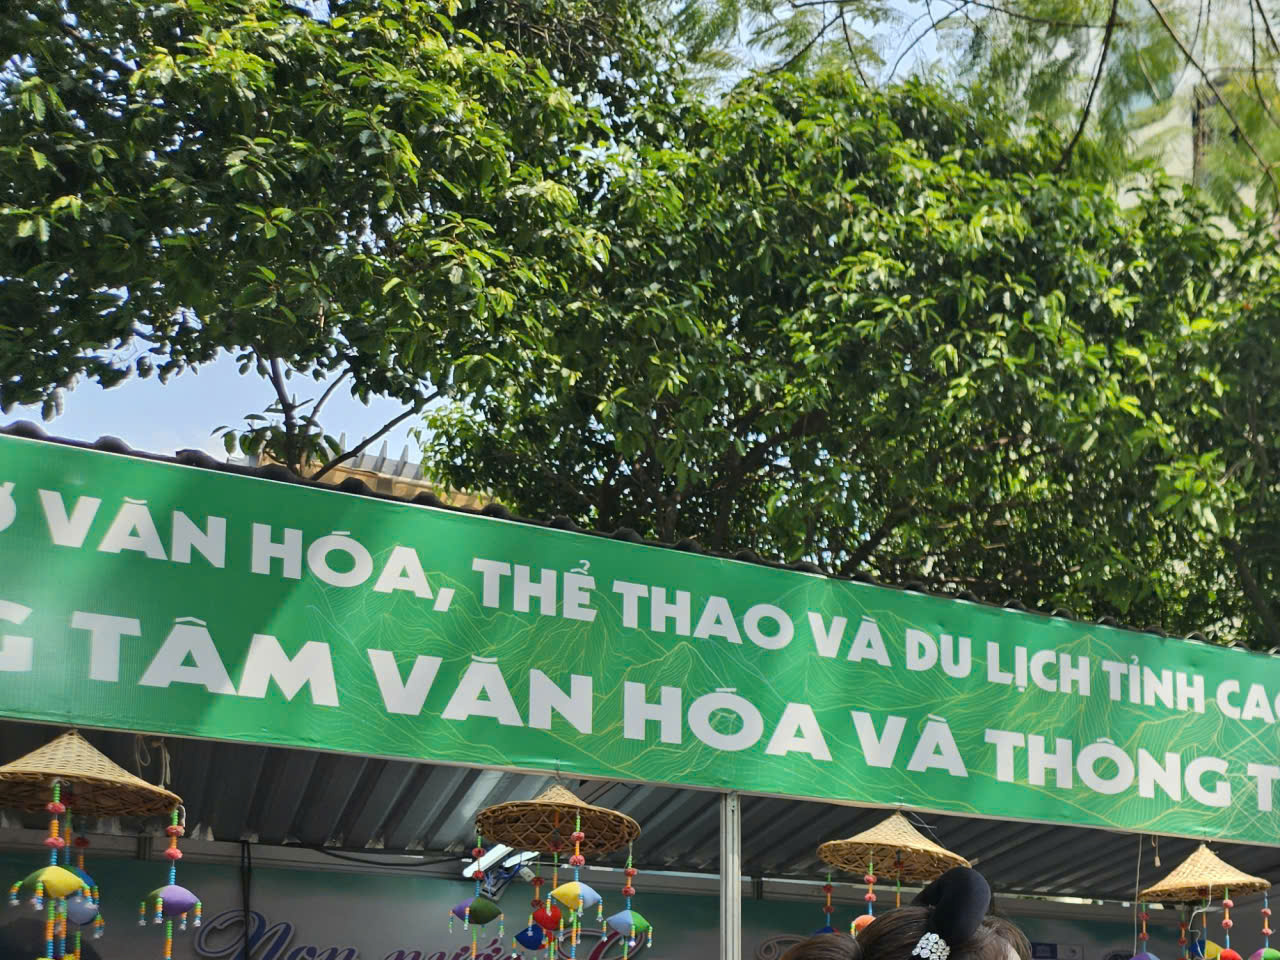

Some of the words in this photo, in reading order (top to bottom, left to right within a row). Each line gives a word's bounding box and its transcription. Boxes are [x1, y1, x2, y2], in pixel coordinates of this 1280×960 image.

[38, 488, 226, 568] VĂN
[252, 523, 455, 612] HÓA,
[472, 559, 597, 622] THỂ
[612, 580, 794, 650] THAO
[808, 611, 892, 667] VÀ
[905, 628, 972, 678] DU
[987, 641, 1090, 697] LỊCH
[1102, 655, 1205, 714] TỈNH
[70, 610, 340, 707] TÂM
[367, 648, 593, 734] VĂN
[623, 680, 833, 762] HÓA
[851, 709, 969, 778] VÀ
[984, 728, 1232, 808] THÔNG
